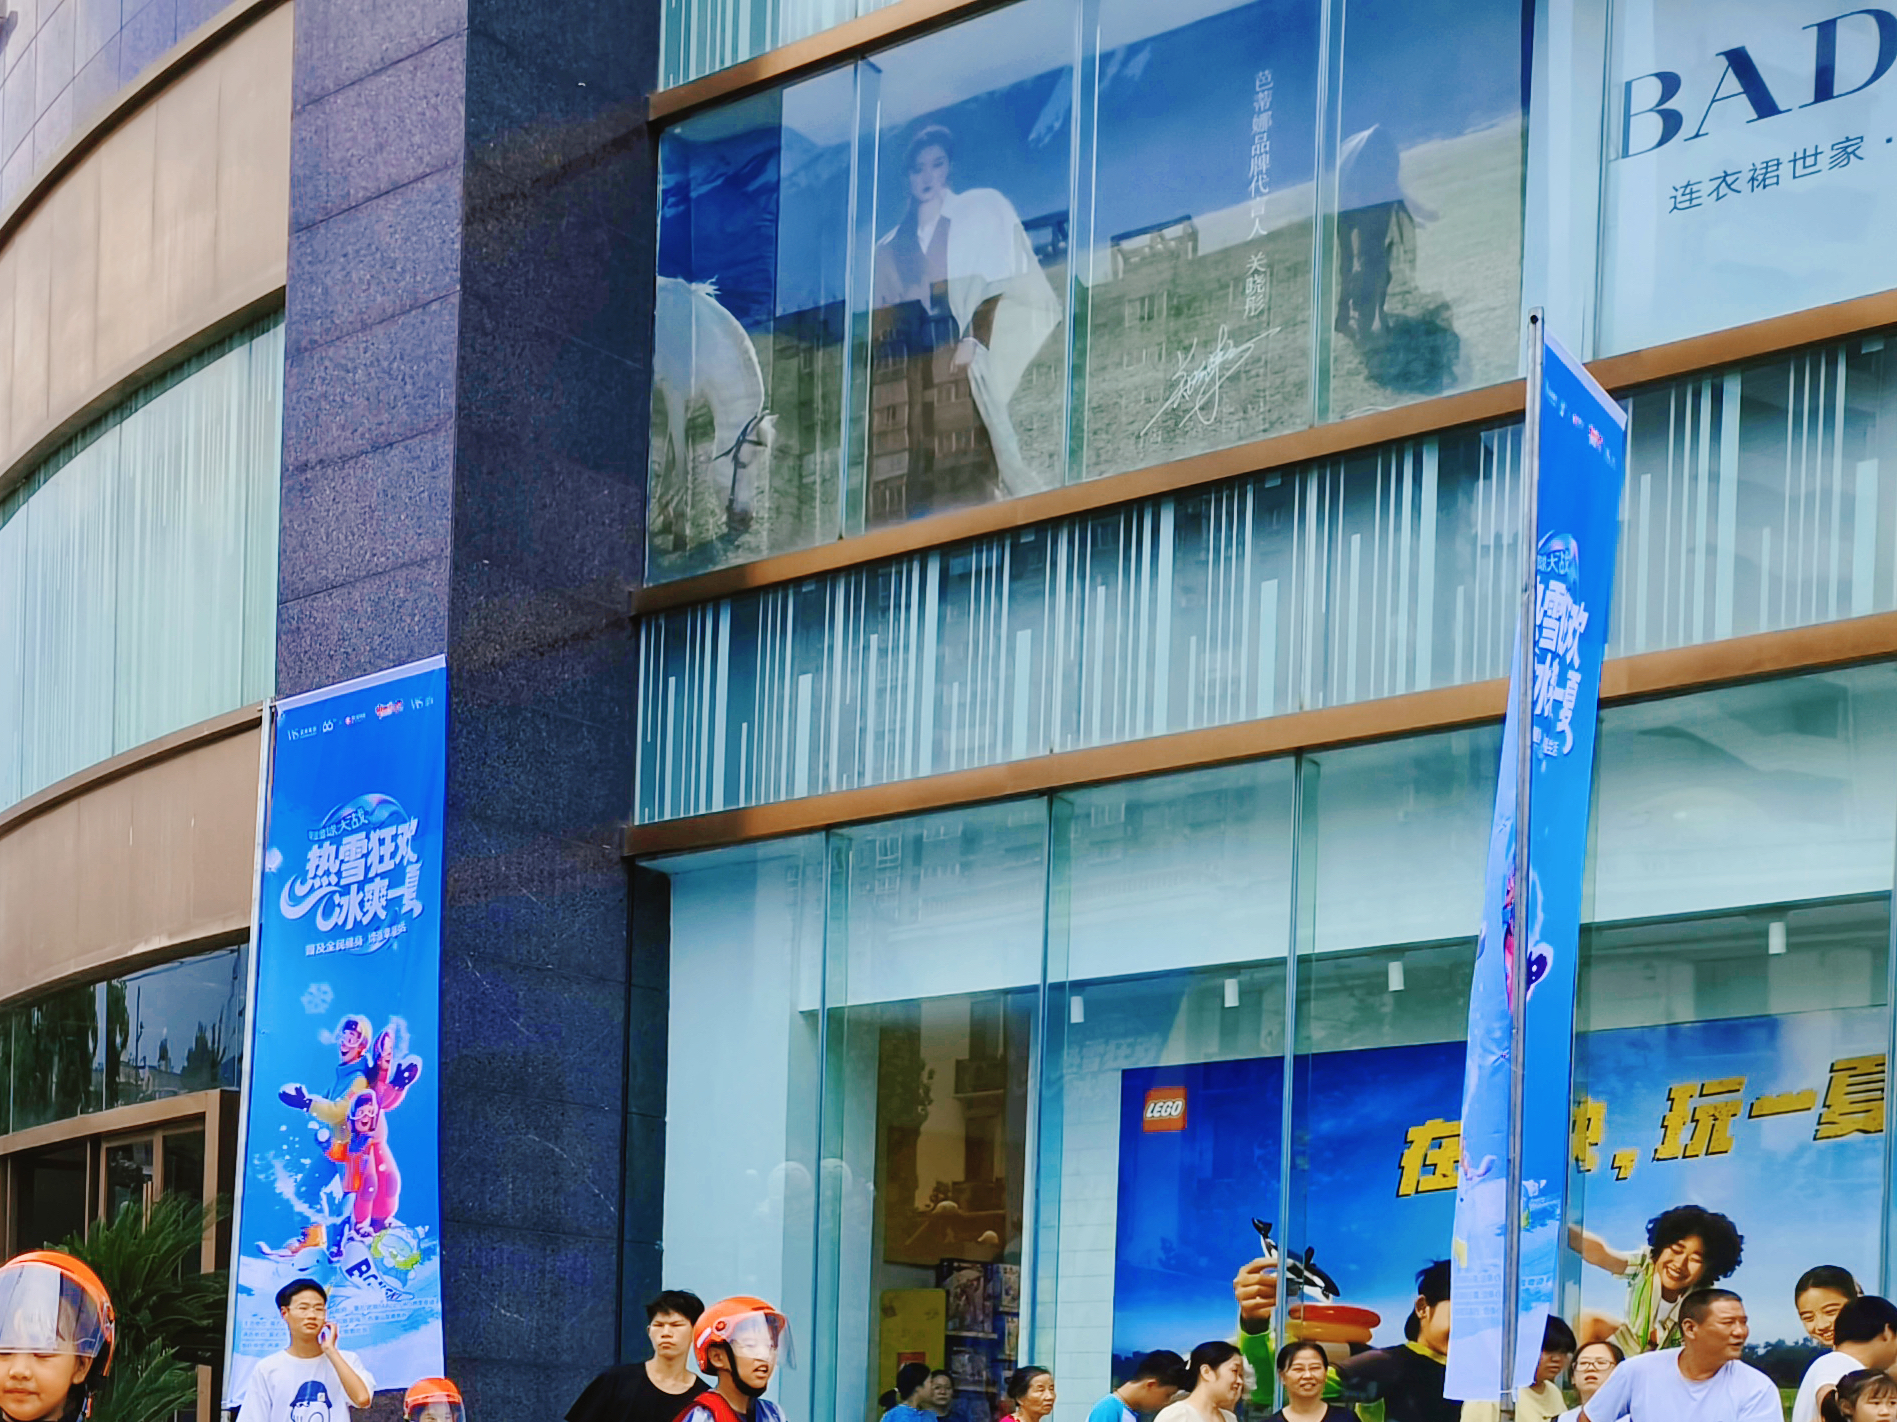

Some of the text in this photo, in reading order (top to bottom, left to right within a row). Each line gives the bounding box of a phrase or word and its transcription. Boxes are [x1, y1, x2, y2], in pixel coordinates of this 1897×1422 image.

[1669, 135, 1865, 214] 连衣裙世家
[297, 816, 420, 893] 热雪狂欢
[316, 861, 424, 932] 冰爽一夏
[1144, 1098, 1185, 1119] LEGO
